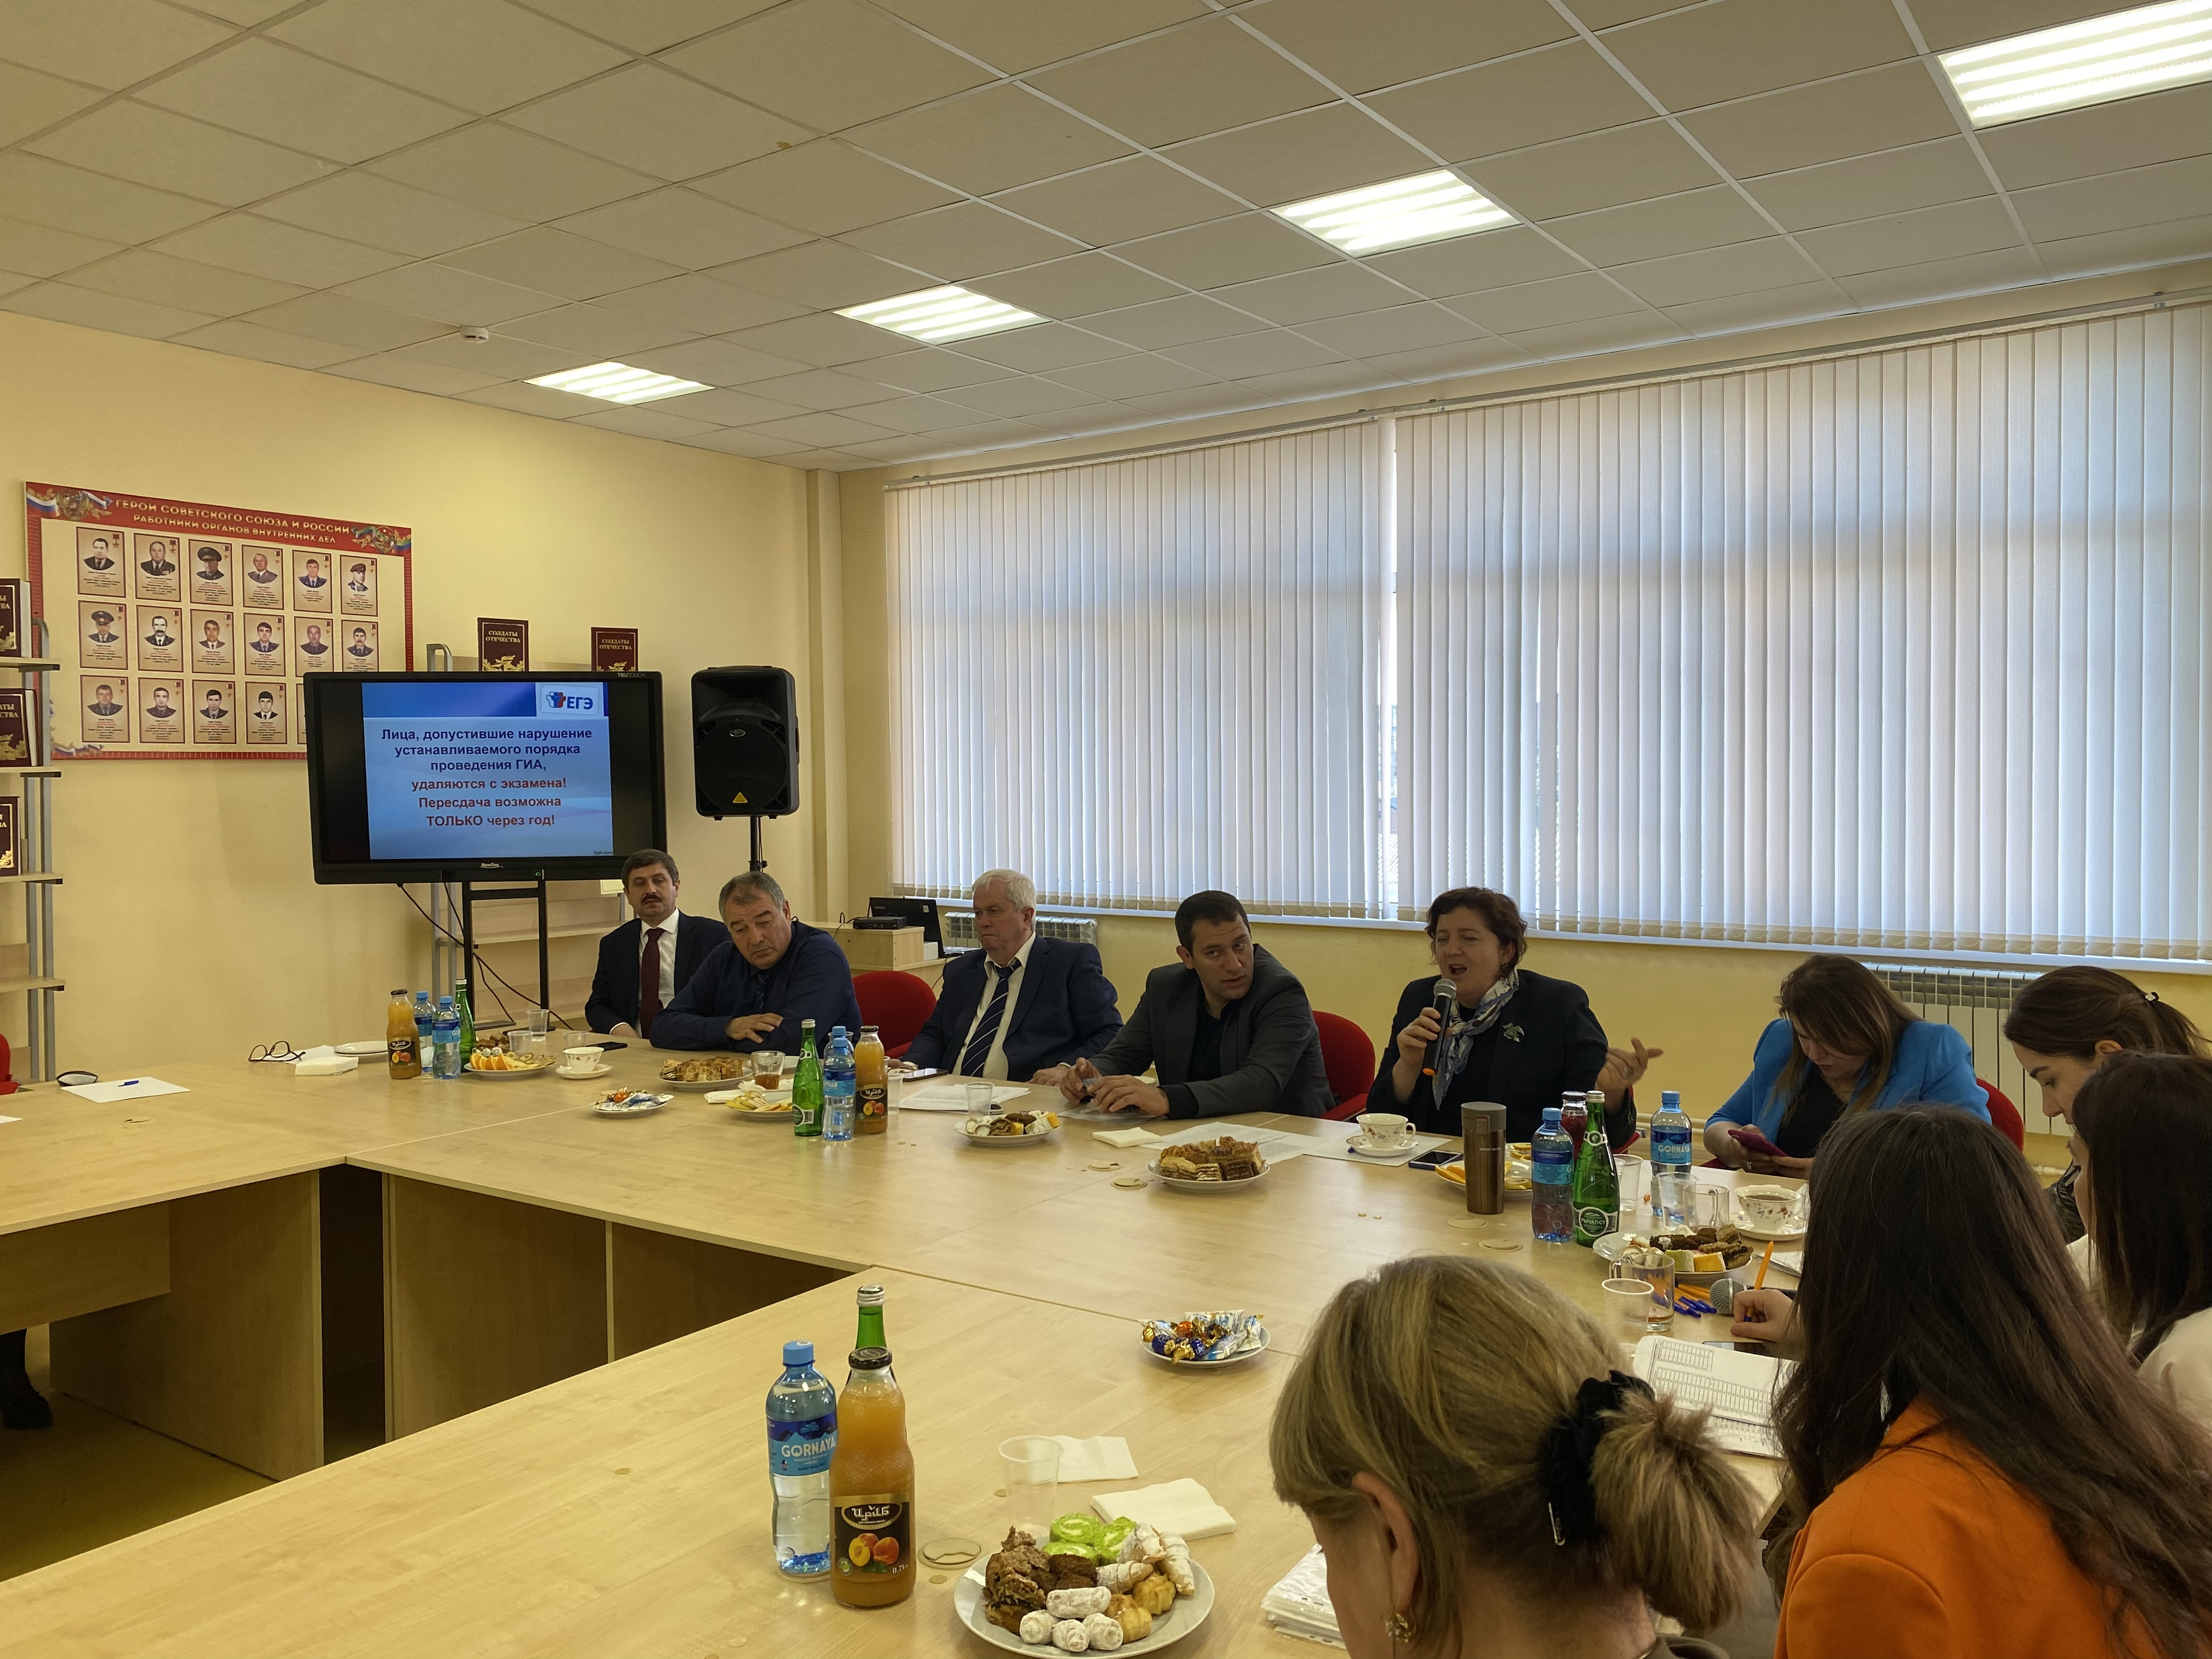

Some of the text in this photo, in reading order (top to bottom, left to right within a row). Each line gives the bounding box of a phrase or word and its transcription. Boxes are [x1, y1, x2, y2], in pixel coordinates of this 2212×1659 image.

[116, 499, 350, 534] ГЕРОИ СОВЕТСКОГО СОЮЗА И РОССИИ
[133, 514, 199, 529] РАБОТНИКИ
[201, 522, 250, 534] ОРГАНОВ
[252, 528, 315, 541] ВНУТРЕННИХ
[567, 696, 594, 710] ЕГЭ
[381, 729, 592, 741] Лица, допустившие нарушение
[394, 746, 580, 757] устанавливаемого порядка
[431, 759, 546, 772] проведения ГИА,
[411, 778, 566, 792] удаляются с экзамена!
[419, 797, 561, 810] Пересдача возможна
[427, 815, 555, 827] ТОЛЬКО через год!
[1658, 1144, 1690, 1153] GORNAYA
[781, 1436, 836, 1458] GORNAYA
